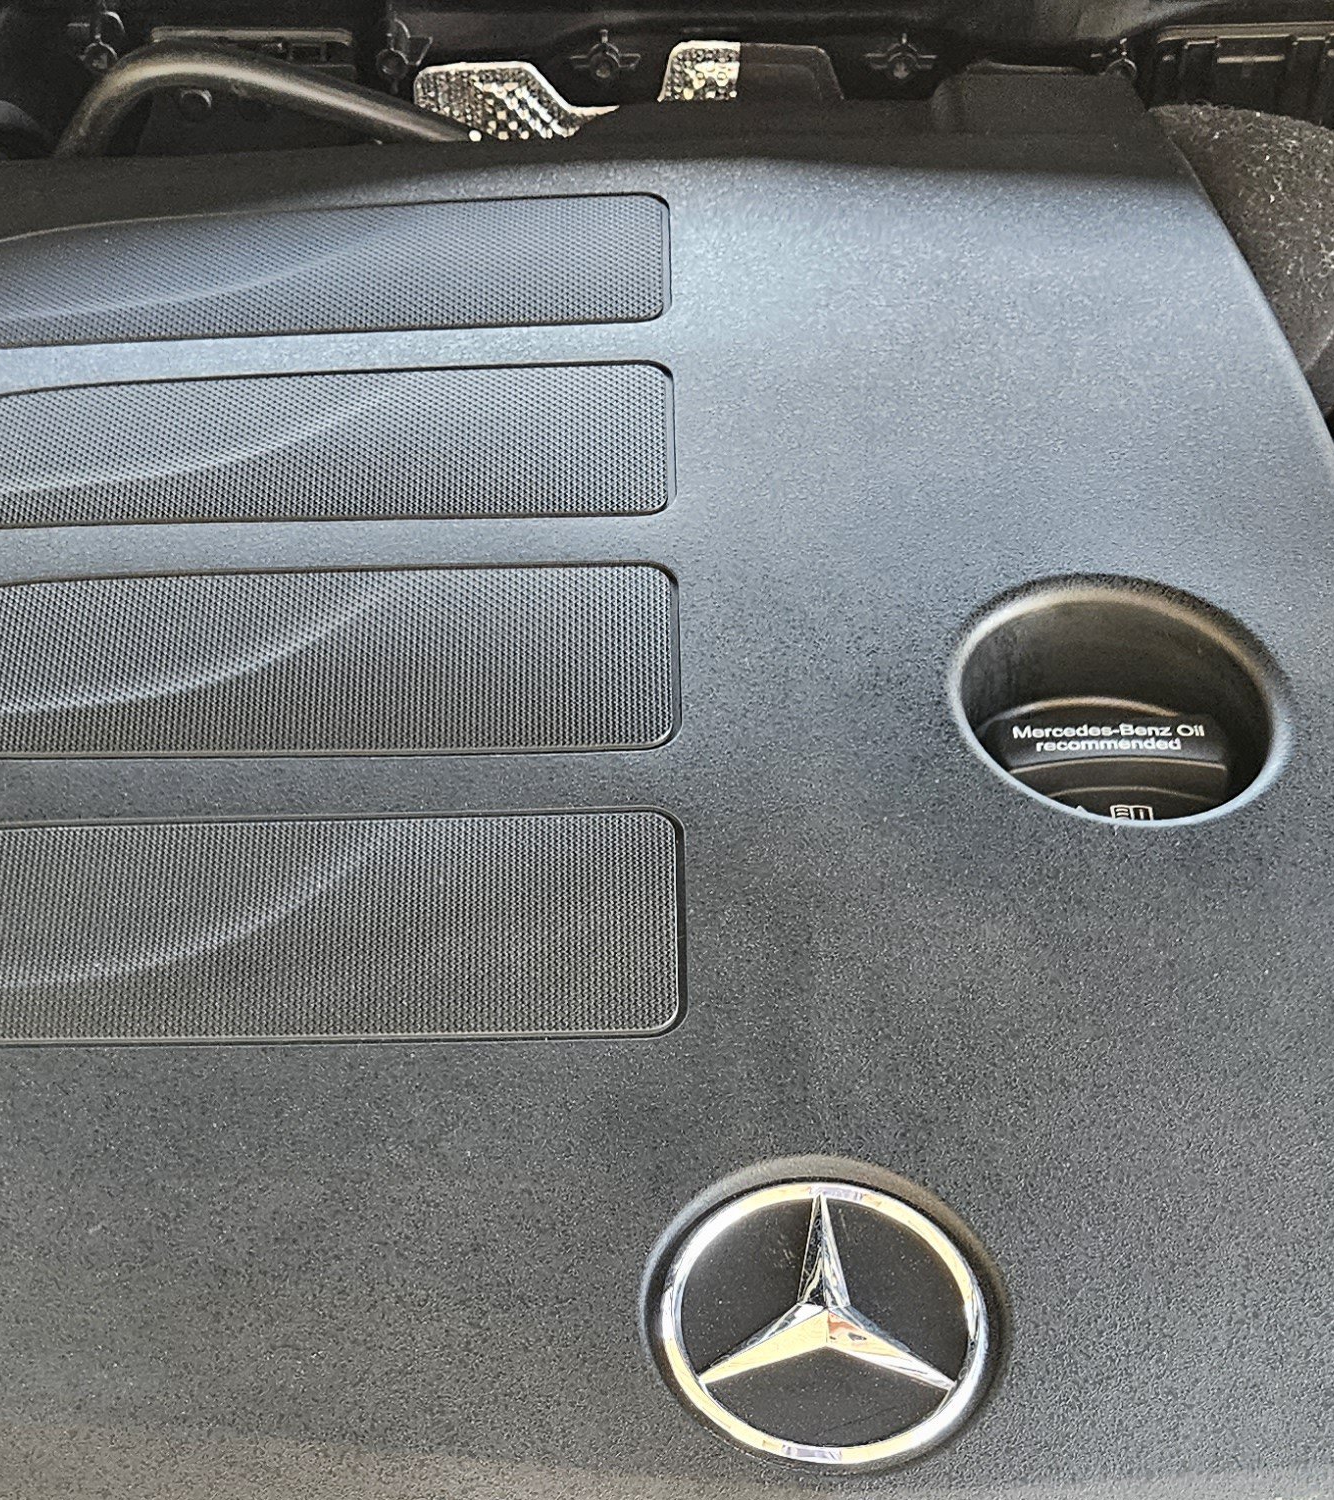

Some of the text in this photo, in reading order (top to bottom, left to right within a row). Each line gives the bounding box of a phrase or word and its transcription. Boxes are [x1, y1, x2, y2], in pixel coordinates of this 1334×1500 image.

[1012, 723, 1205, 739] Mercedes-Benz Oil
[1035, 737, 1182, 752] recommended
